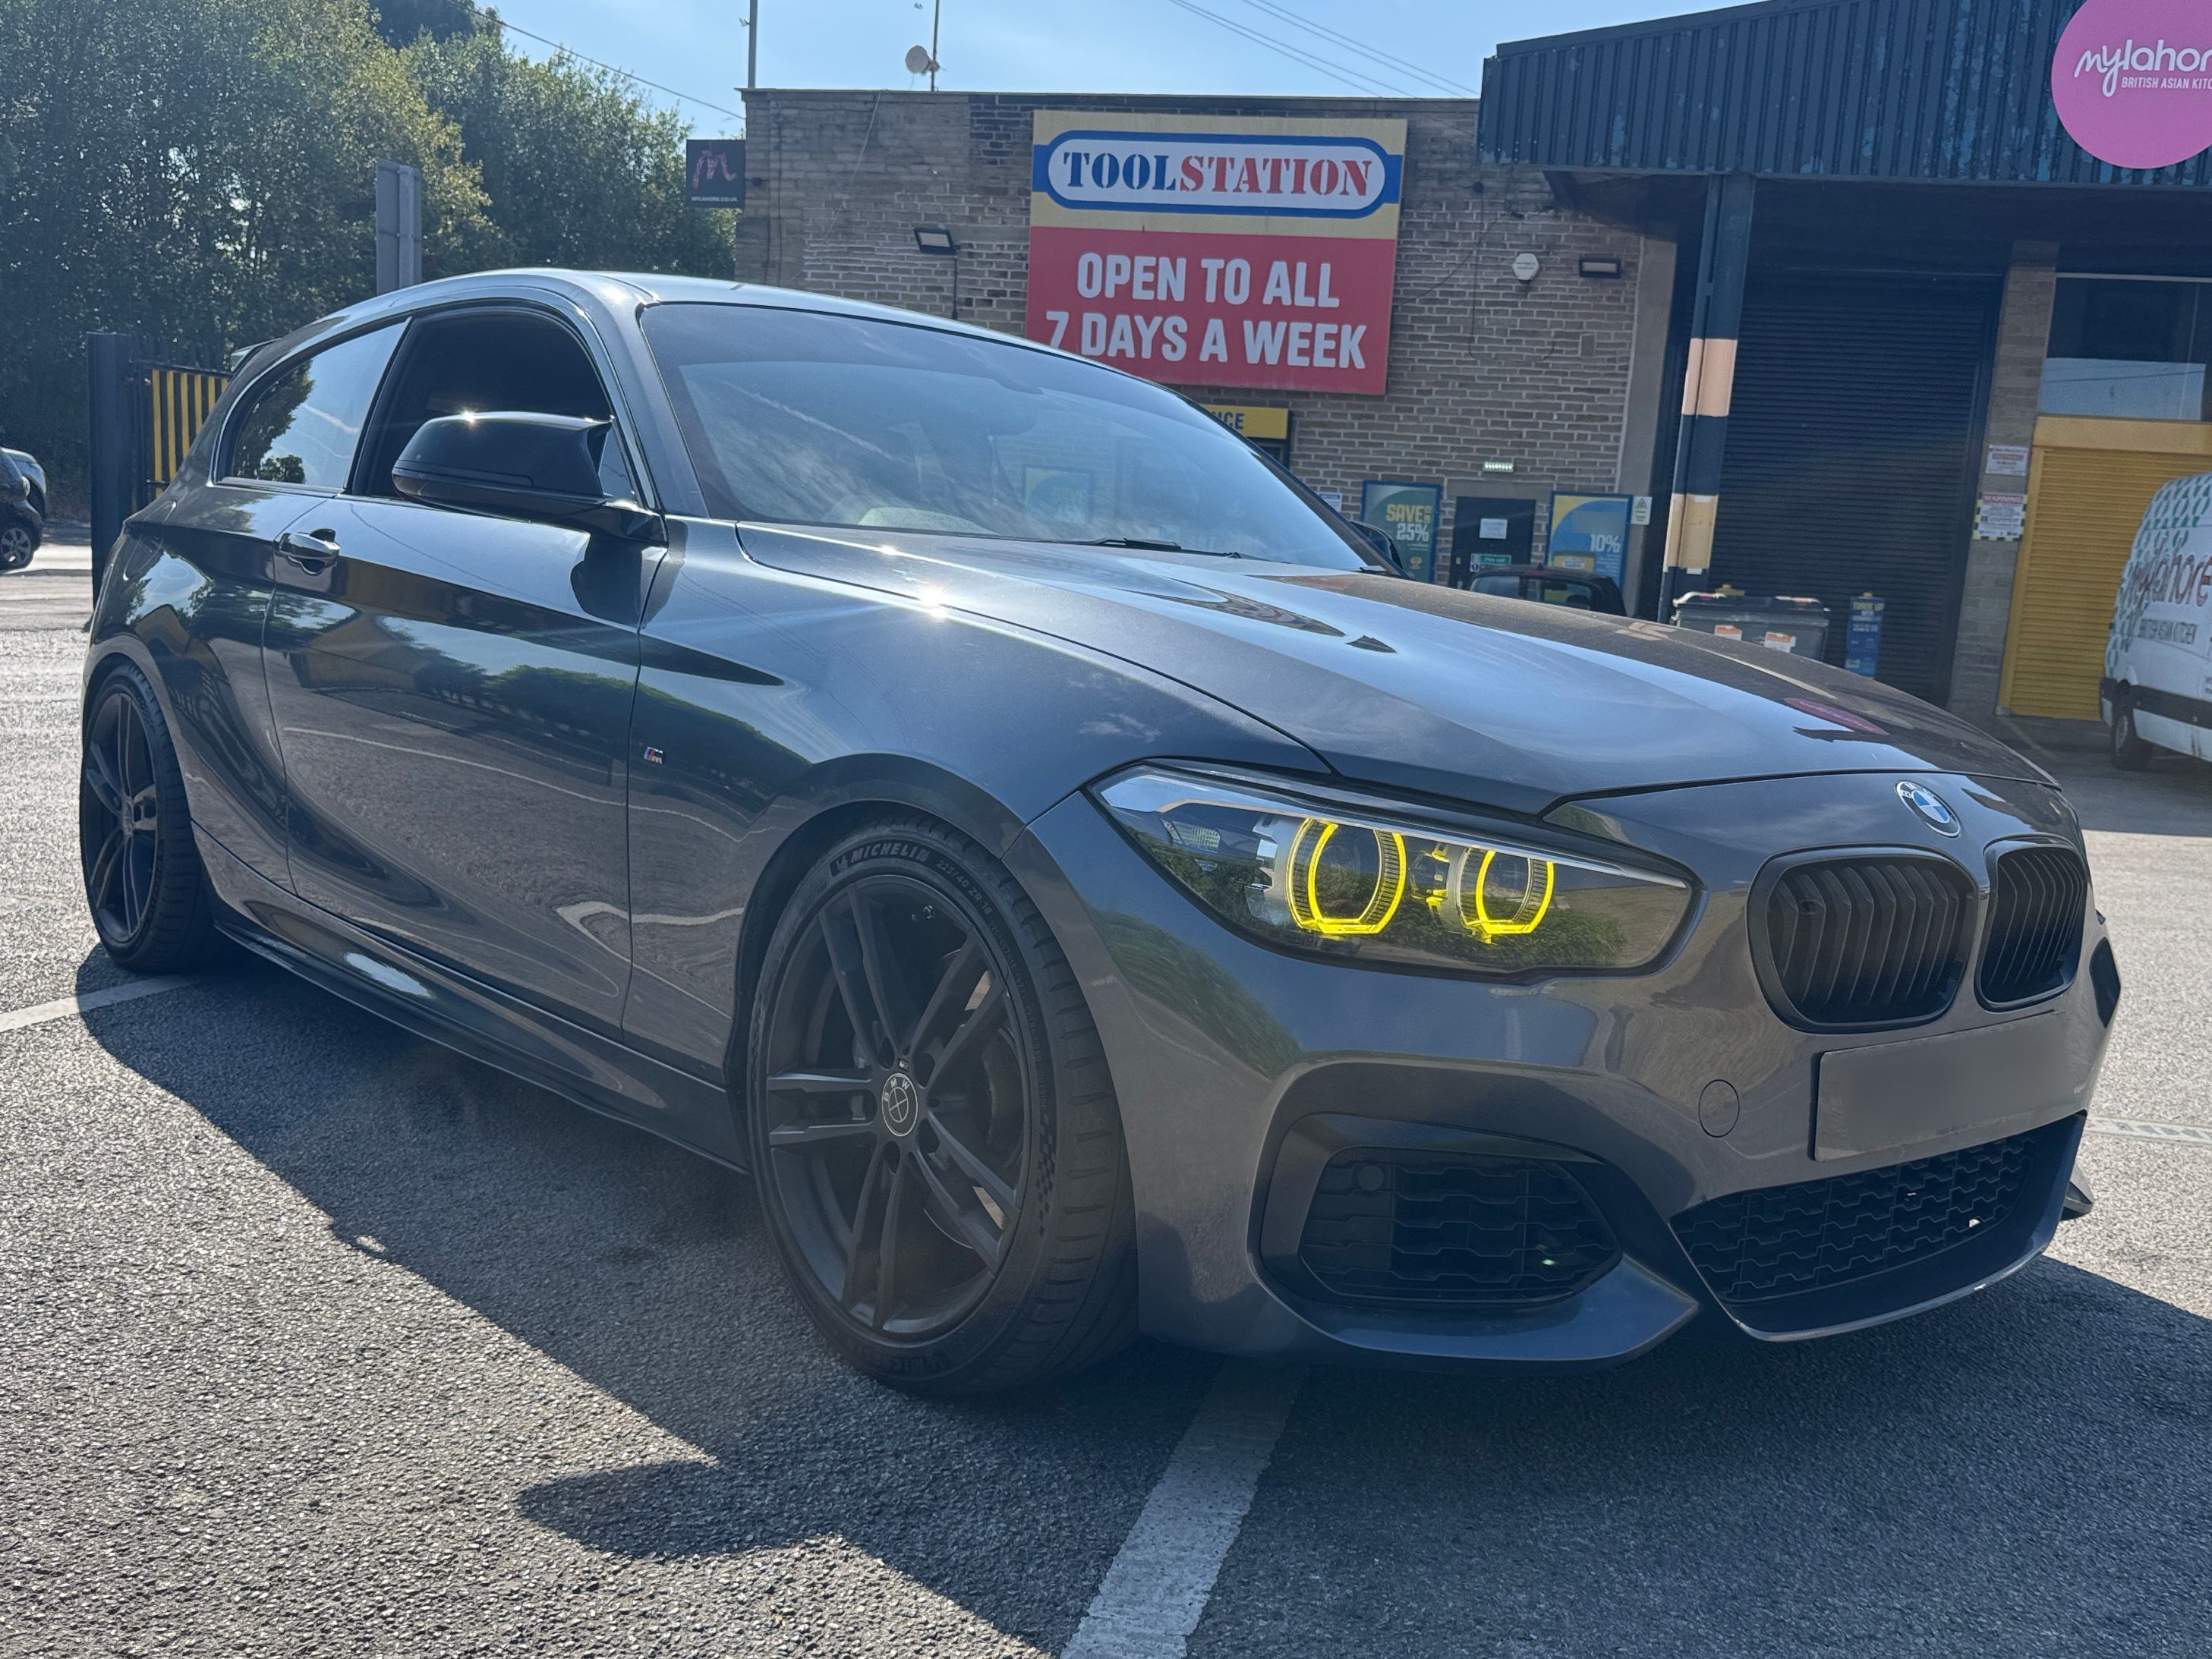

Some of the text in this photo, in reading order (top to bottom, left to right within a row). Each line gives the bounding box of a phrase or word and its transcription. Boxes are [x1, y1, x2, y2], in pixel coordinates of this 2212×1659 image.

[2121, 76, 2159, 89] BRITISH
[2160, 77, 2189, 89] ASIAN
[1063, 151, 1373, 197] TOOLSTATION
[1076, 251, 1340, 308] OPEN TO ALL
[1045, 310, 1368, 370] 7 DAYS A WEEK
[1385, 504, 1424, 523] SAVE
[1396, 522, 1429, 542] 25%
[1590, 534, 1621, 552] 10%
[850, 842, 932, 863] MICHELIN
[884, 1078, 910, 1102] BMW
